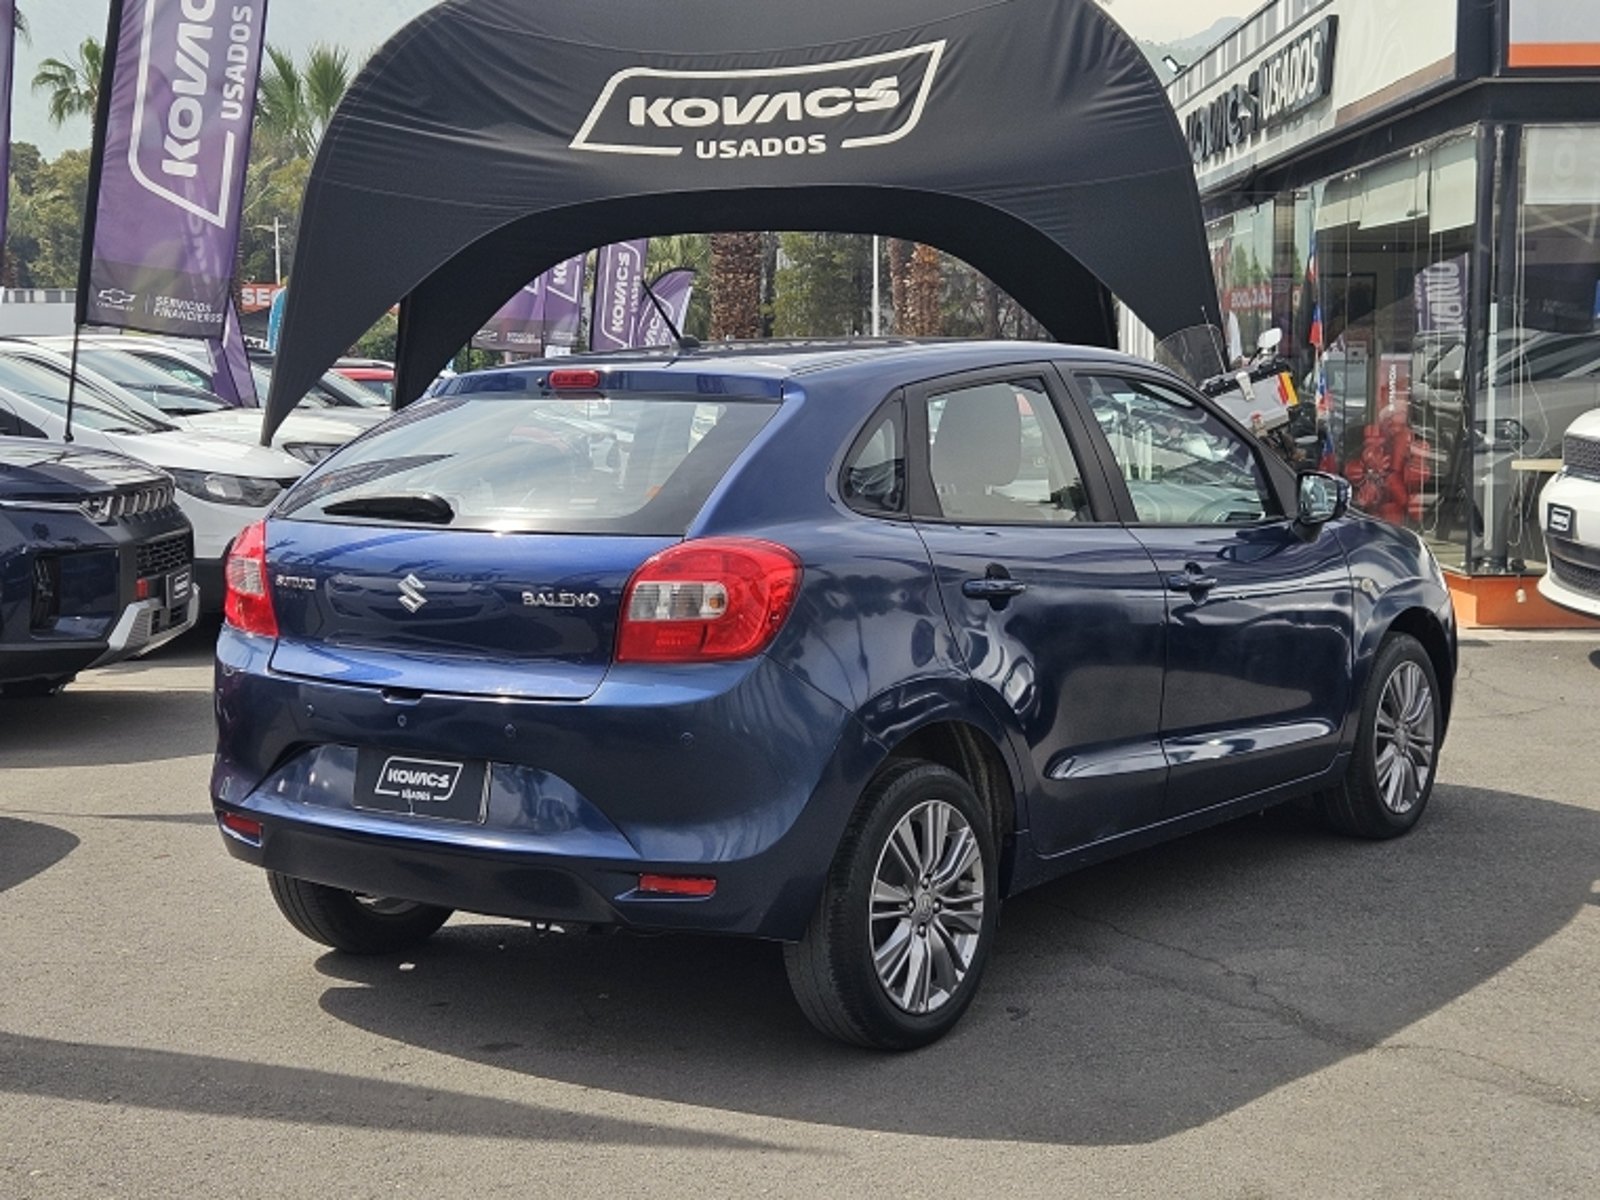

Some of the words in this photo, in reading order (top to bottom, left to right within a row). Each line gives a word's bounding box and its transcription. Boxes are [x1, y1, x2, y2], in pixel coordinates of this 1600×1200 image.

[220, 5, 253, 121] USADOS
[1262, 30, 1321, 121] USADOS
[628, 75, 900, 128] KOVACS
[695, 133, 827, 160] USADOS
[611, 251, 630, 332] KOVACS
[521, 590, 600, 608] BALENO
[386, 767, 451, 789] KOVACS
